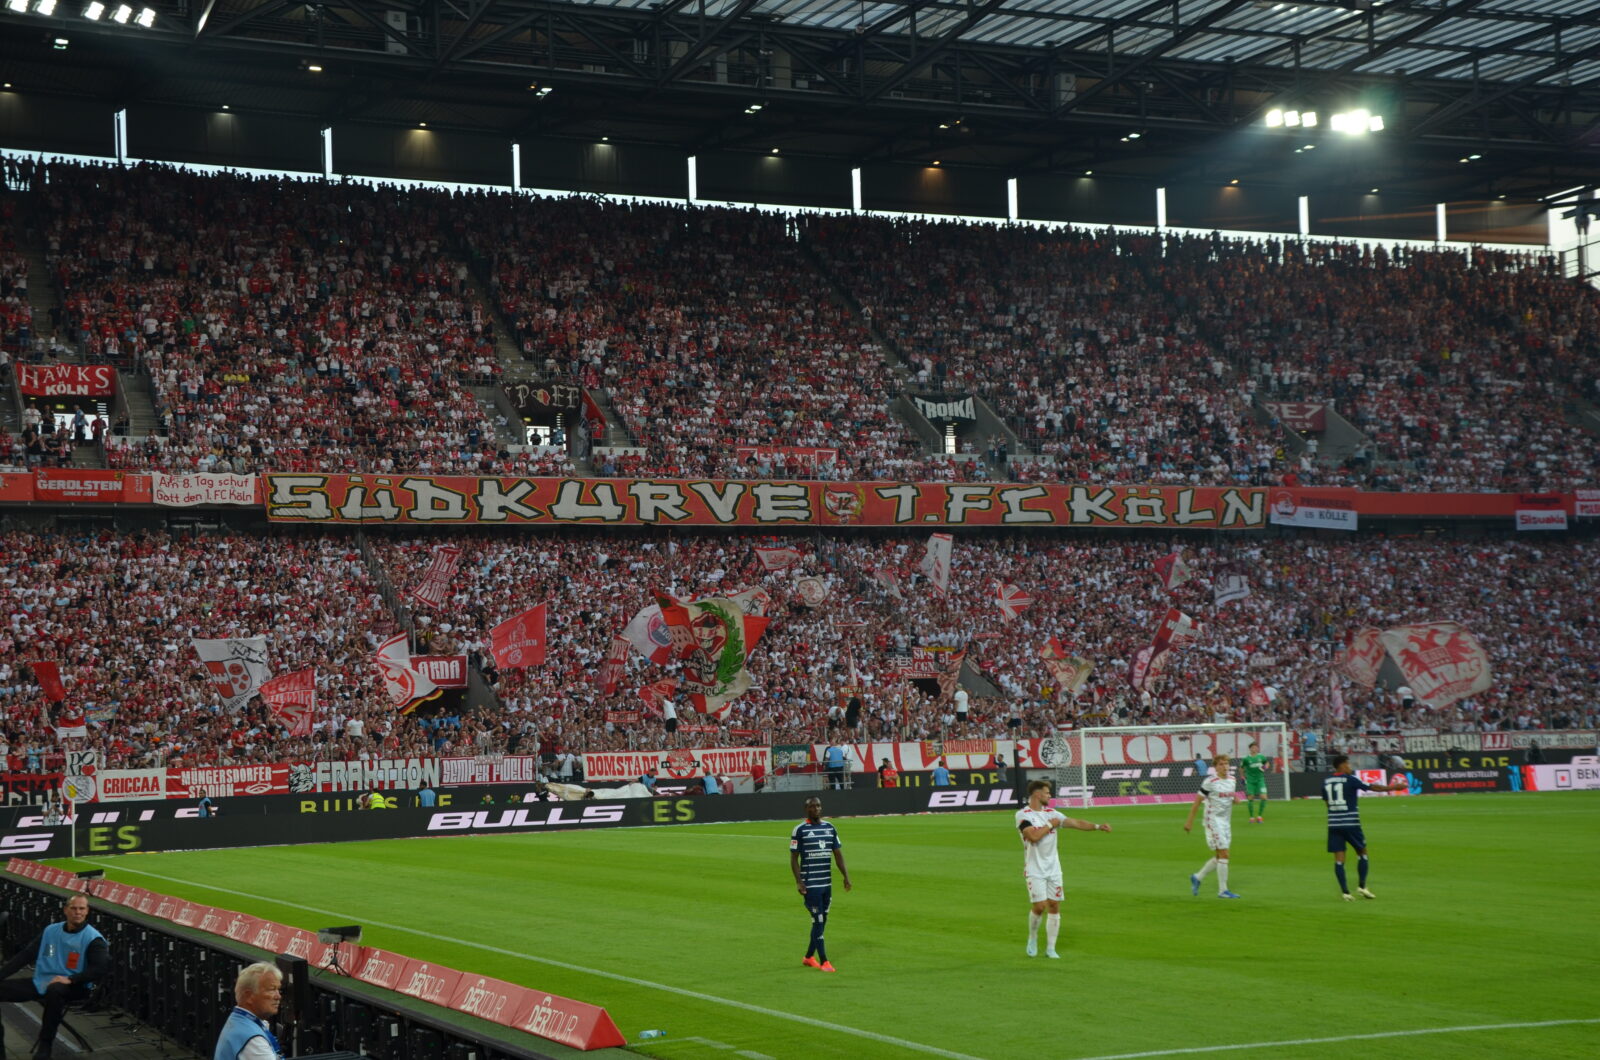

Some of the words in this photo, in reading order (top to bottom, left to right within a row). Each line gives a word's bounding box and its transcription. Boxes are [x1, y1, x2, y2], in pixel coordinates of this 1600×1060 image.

[21, 365, 110, 388] HAWKS
[45, 381, 89, 395] KÖLN
[915, 397, 976, 420] TROIKA
[37, 479, 122, 491] GEROLSTEIN
[182, 477, 194, 488] 8.
[195, 475, 215, 489] Tag
[218, 474, 250, 488] schuf
[156, 489, 181, 504] Gott
[183, 490, 203, 503] den
[213, 489, 227, 501] FC
[228, 488, 253, 502] Köln
[268, 475, 811, 523] SÜDKURVE
[1319, 510, 1349, 521] KÖLLE
[442, 759, 489, 783] SEMPER
[586, 754, 660, 777] DOMSTADT
[701, 749, 768, 774] SYNDIKAT
[103, 775, 160, 794] CRICCAA
[181, 766, 273, 786] MÜNGERSDORFER
[316, 757, 440, 793] FRAKTION
[188, 783, 234, 799] STADION
[1324, 782, 1347, 805] 11
[427, 806, 626, 831] BULLS
[653, 800, 696, 822] ES
[89, 826, 143, 851] ES
[404, 970, 445, 1001] DERTOUR
[460, 986, 507, 1021] DERTOUR
[525, 1003, 578, 1042] DERTOUR
